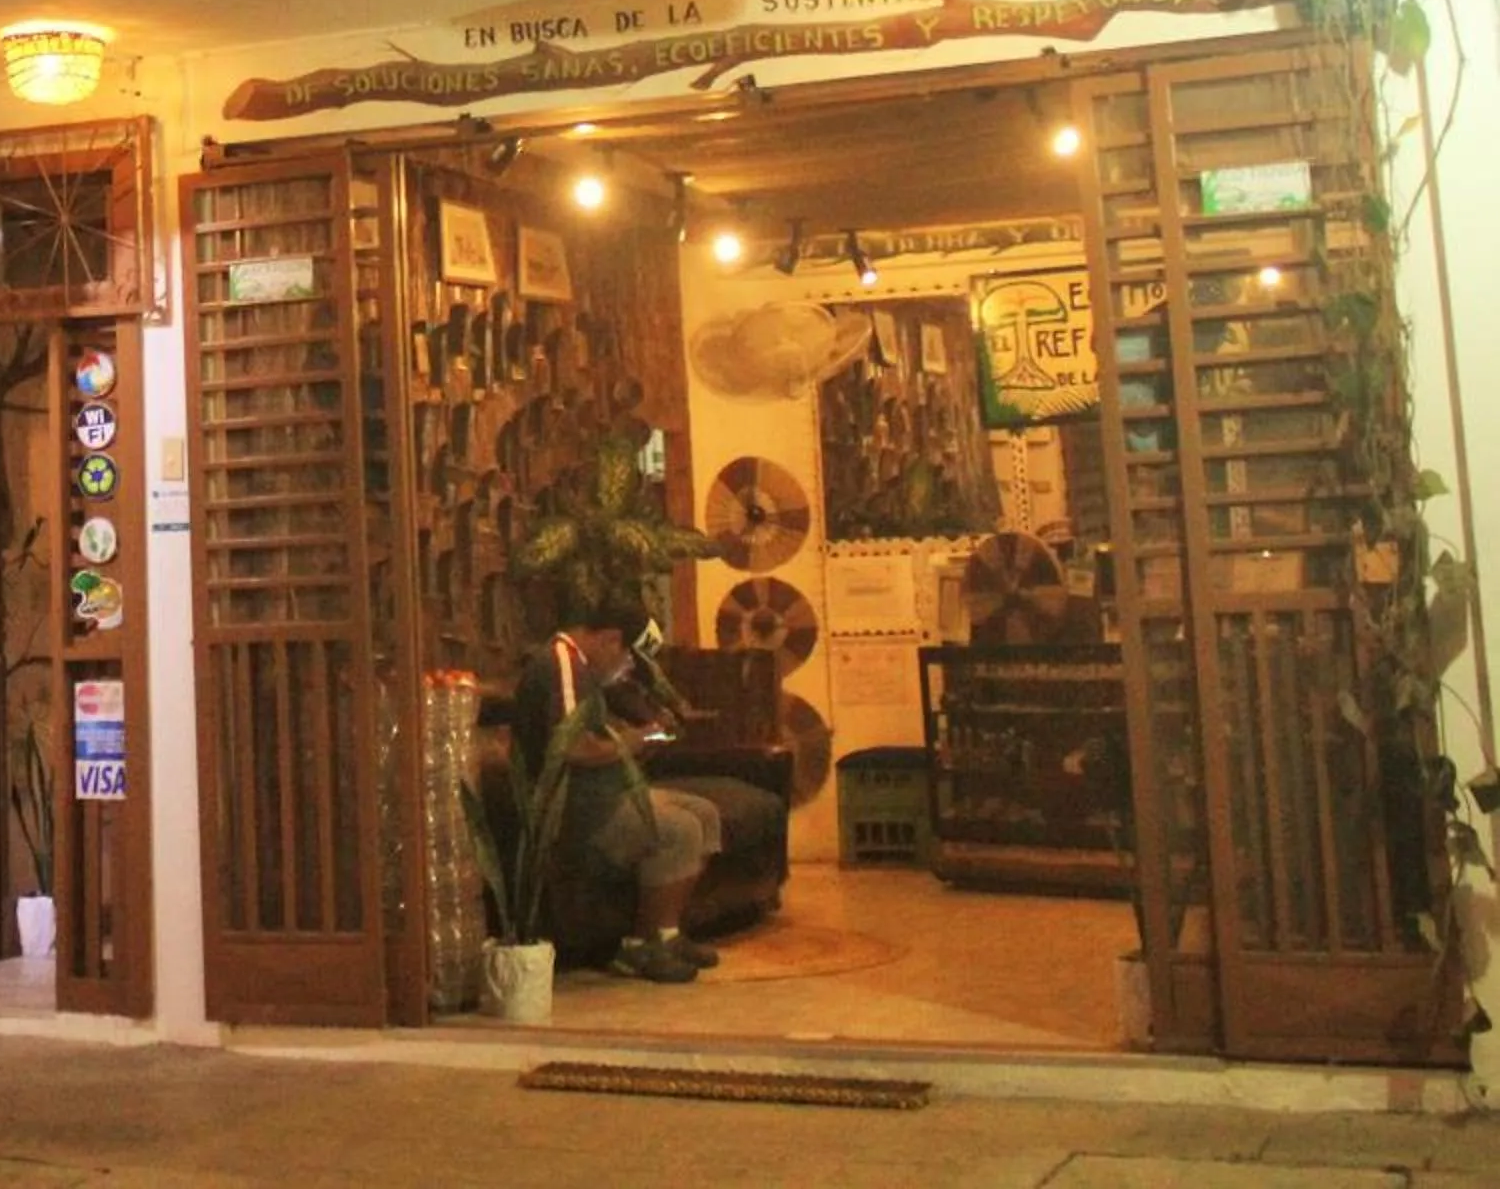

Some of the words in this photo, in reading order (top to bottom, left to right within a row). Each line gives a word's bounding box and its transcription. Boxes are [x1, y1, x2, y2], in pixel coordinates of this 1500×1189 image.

[464, 28, 496, 49] EN
[510, 16, 589, 44] BUSCA
[615, 10, 645, 33] DE
[668, 1, 702, 25] LA
[334, 67, 500, 98] SOLUCIONES
[653, 23, 884, 67] ECOEFICIENTES
[915, 15, 940, 41] Y
[80, 766, 126, 794] VISA
